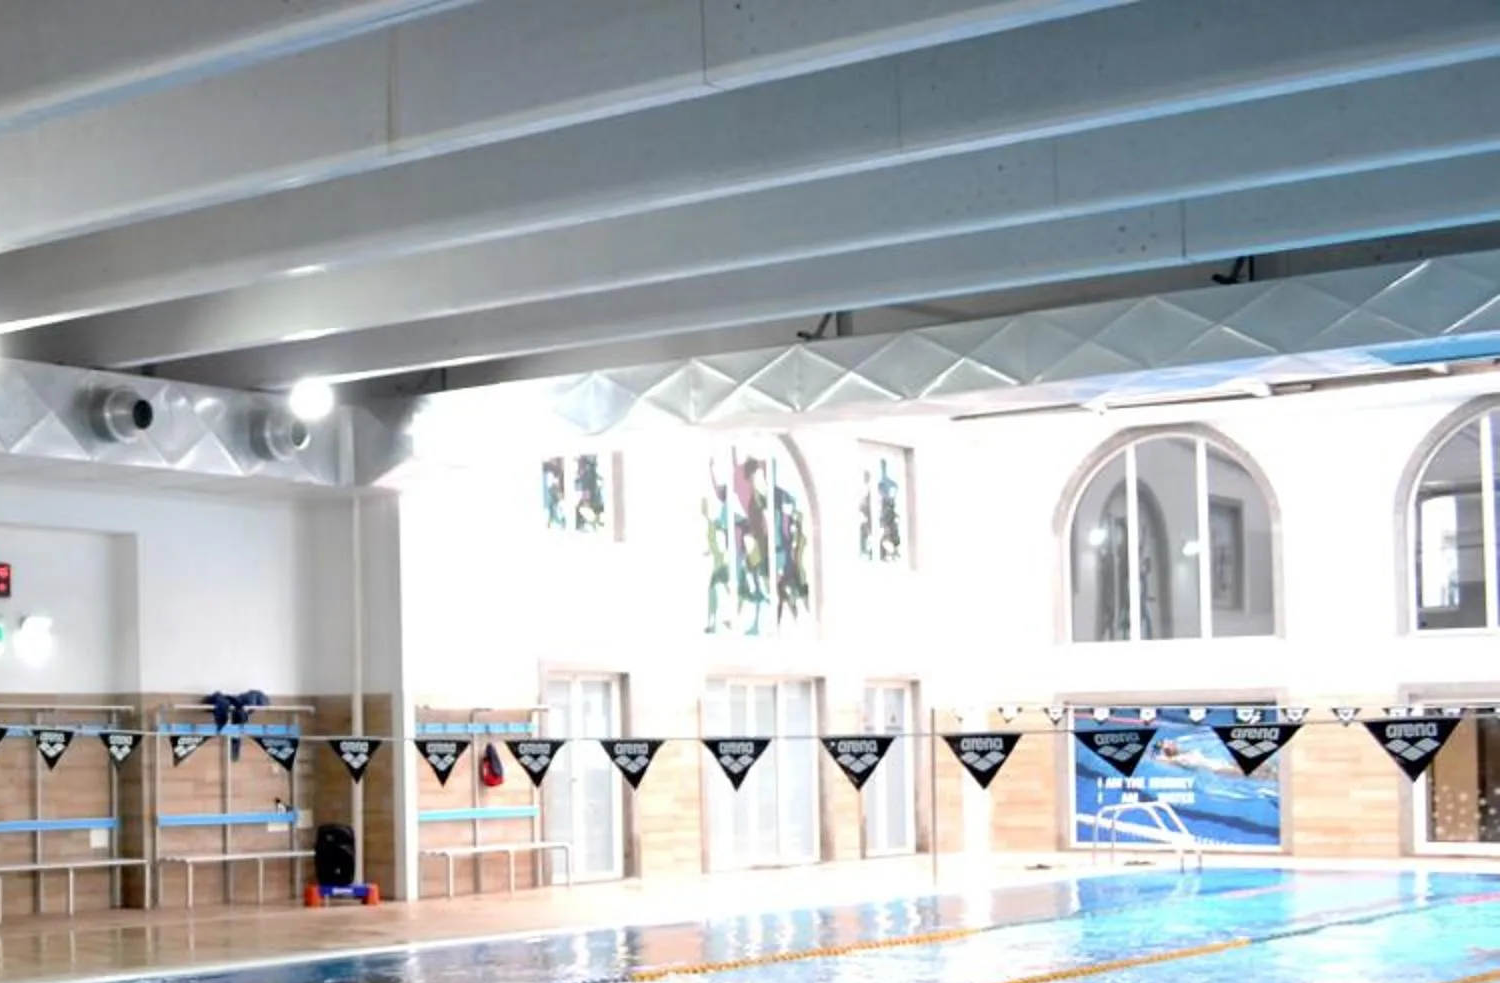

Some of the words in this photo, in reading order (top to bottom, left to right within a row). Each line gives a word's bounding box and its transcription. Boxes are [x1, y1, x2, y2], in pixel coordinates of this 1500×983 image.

[1230, 726, 1281, 740] arena
[1385, 722, 1438, 738] arena
[960, 737, 1004, 751] arena
[1093, 731, 1141, 746] arena
[837, 739, 878, 753] arena
